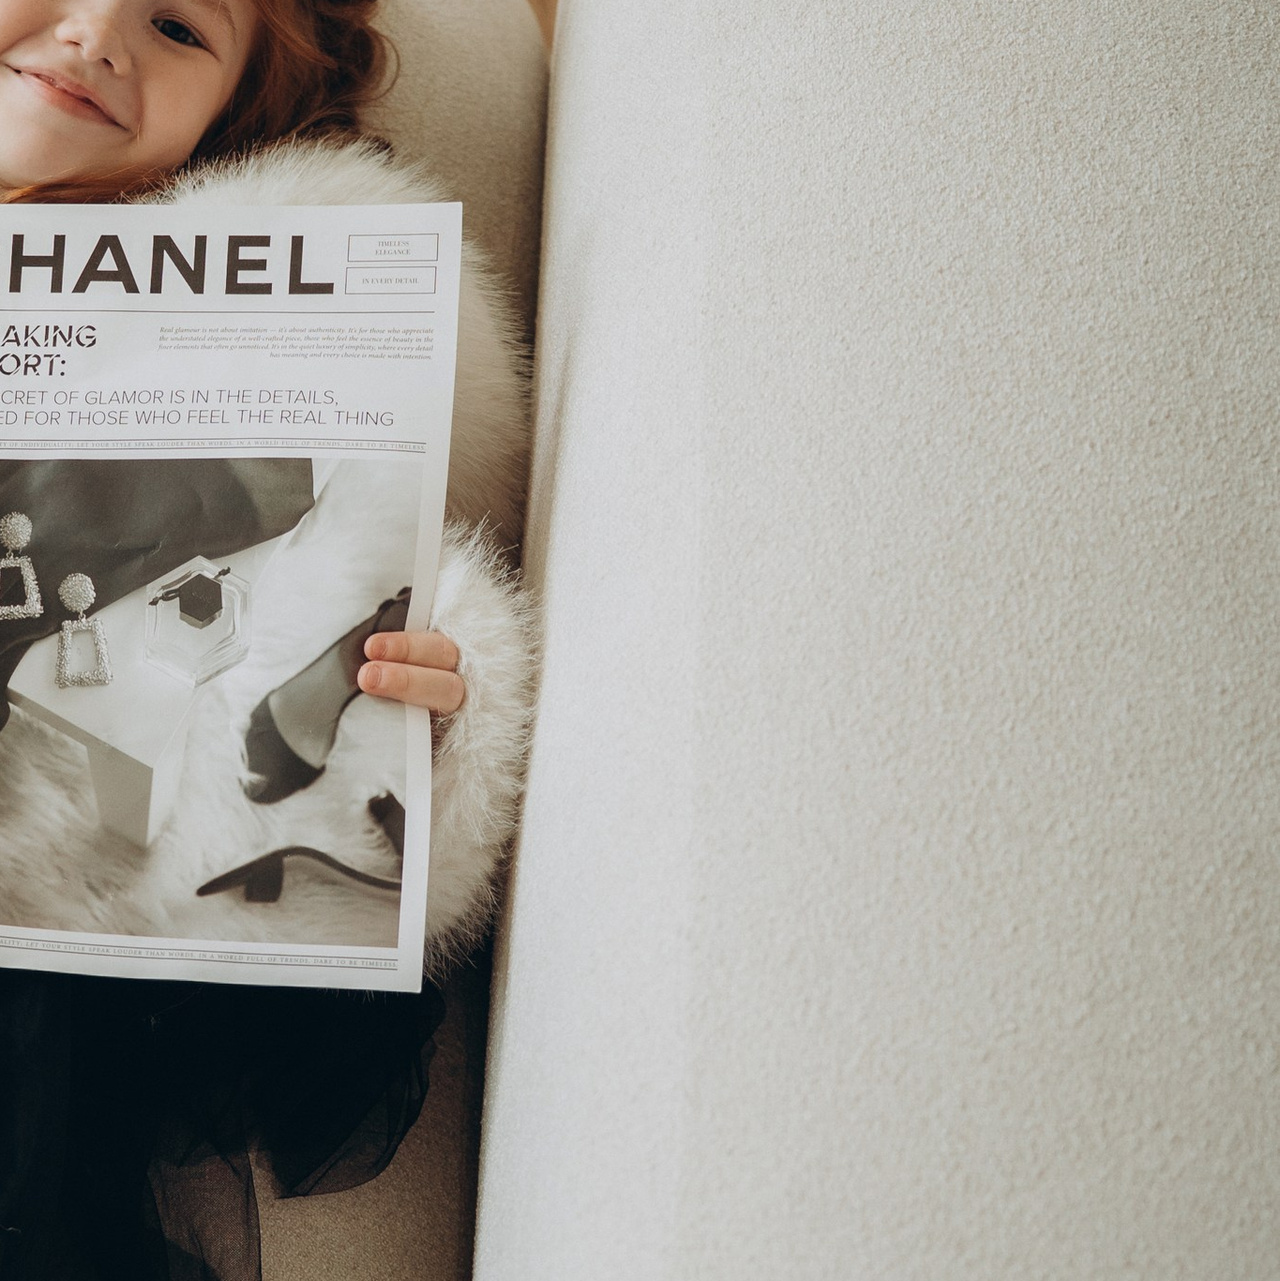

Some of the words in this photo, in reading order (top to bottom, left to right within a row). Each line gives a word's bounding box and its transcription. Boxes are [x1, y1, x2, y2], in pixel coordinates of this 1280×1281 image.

[53, 390, 79, 405] OF
[84, 390, 164, 405] GLAMOR
[169, 389, 185, 404] IS
[191, 389, 209, 403] IN
[216, 389, 252, 403] THE
[258, 389, 338, 405] DETAILS,
[23, 410, 60, 425] FOR
[67, 410, 128, 425] THOSE
[135, 410, 181, 424] WHO
[187, 409, 229, 423] FEEL
[237, 409, 273, 423] THE
[279, 409, 326, 424] REAL
[334, 410, 393, 426] THING
